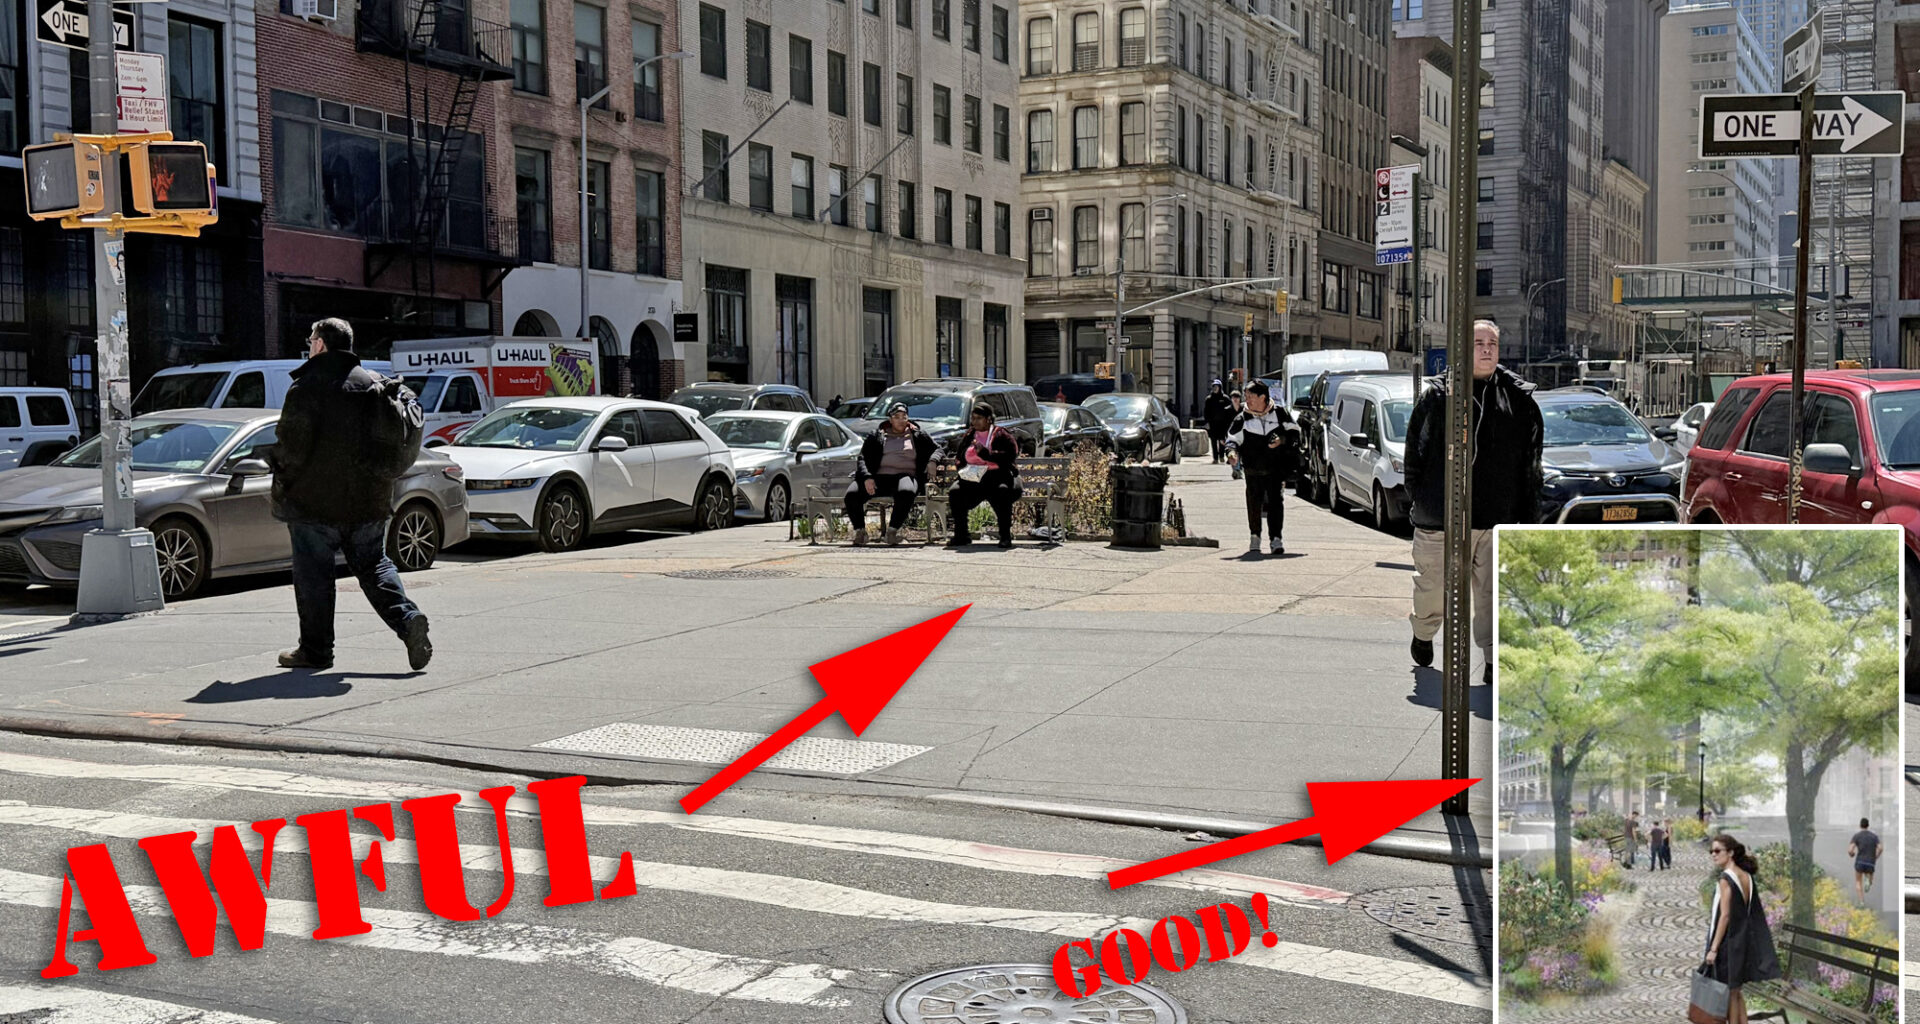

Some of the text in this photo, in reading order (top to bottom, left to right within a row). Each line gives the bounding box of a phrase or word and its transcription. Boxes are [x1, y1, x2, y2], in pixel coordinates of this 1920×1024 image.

[52, 11, 80, 33] ONE
[119, 57, 139, 65] Monday
[1787, 50, 1799, 79] ONE
[1724, 114, 1776, 137] ONE
[1380, 202, 1388, 215] 2
[408, 351, 475, 367] U-HAUL
[497, 348, 547, 362] U-HAUL
